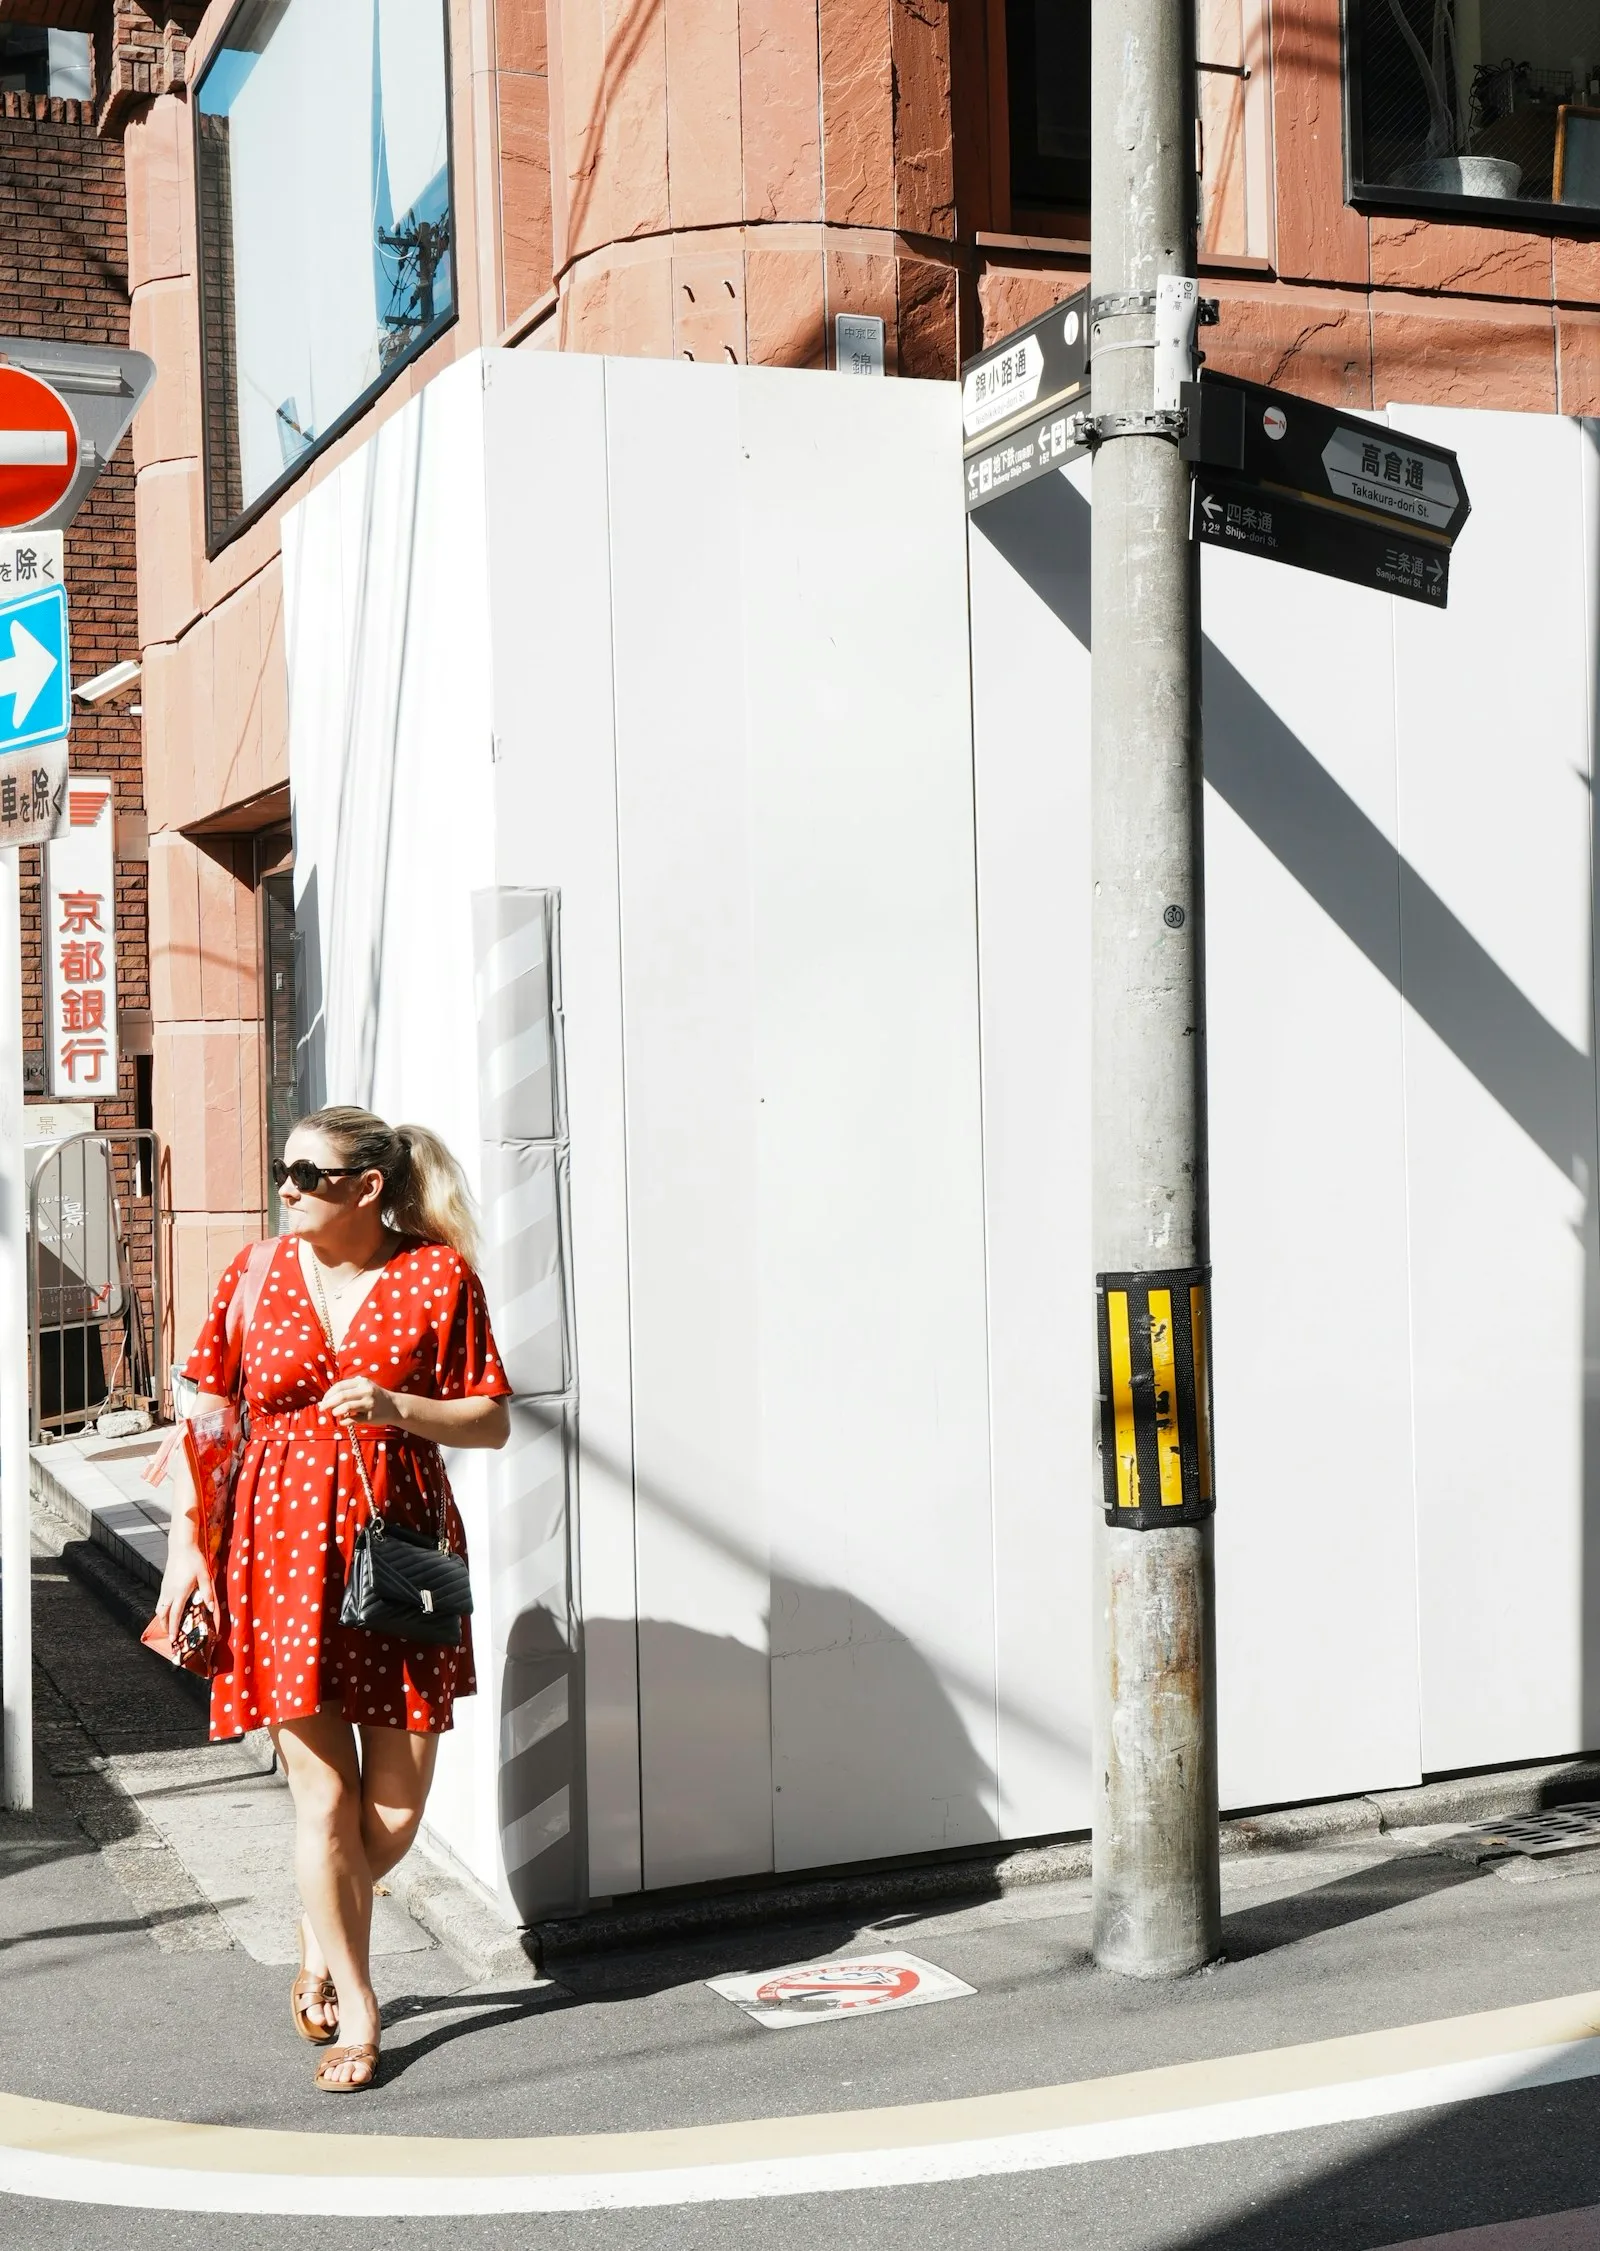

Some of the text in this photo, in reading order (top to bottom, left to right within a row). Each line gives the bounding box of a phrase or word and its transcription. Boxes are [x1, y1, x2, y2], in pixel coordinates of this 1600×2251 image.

[844, 326, 877, 340] 中京区
[850, 352, 872, 375] 錦
[976, 347, 1026, 403] 錦小路通
[1278, 420, 1286, 430] N
[1362, 442, 1424, 491] 高倉通
[1352, 482, 1429, 518] Takakura-dori St.
[1227, 503, 1273, 533] 四条通
[1225, 525, 1279, 548] Shijo-dori St.
[1385, 549, 1424, 577] 三条通
[1376, 567, 1422, 589] Sanjo-dori St.
[1, 767, 62, 828] 車を除く
[1167, 910, 1182, 923] 30
[58, 889, 109, 1084] 京都銀行
